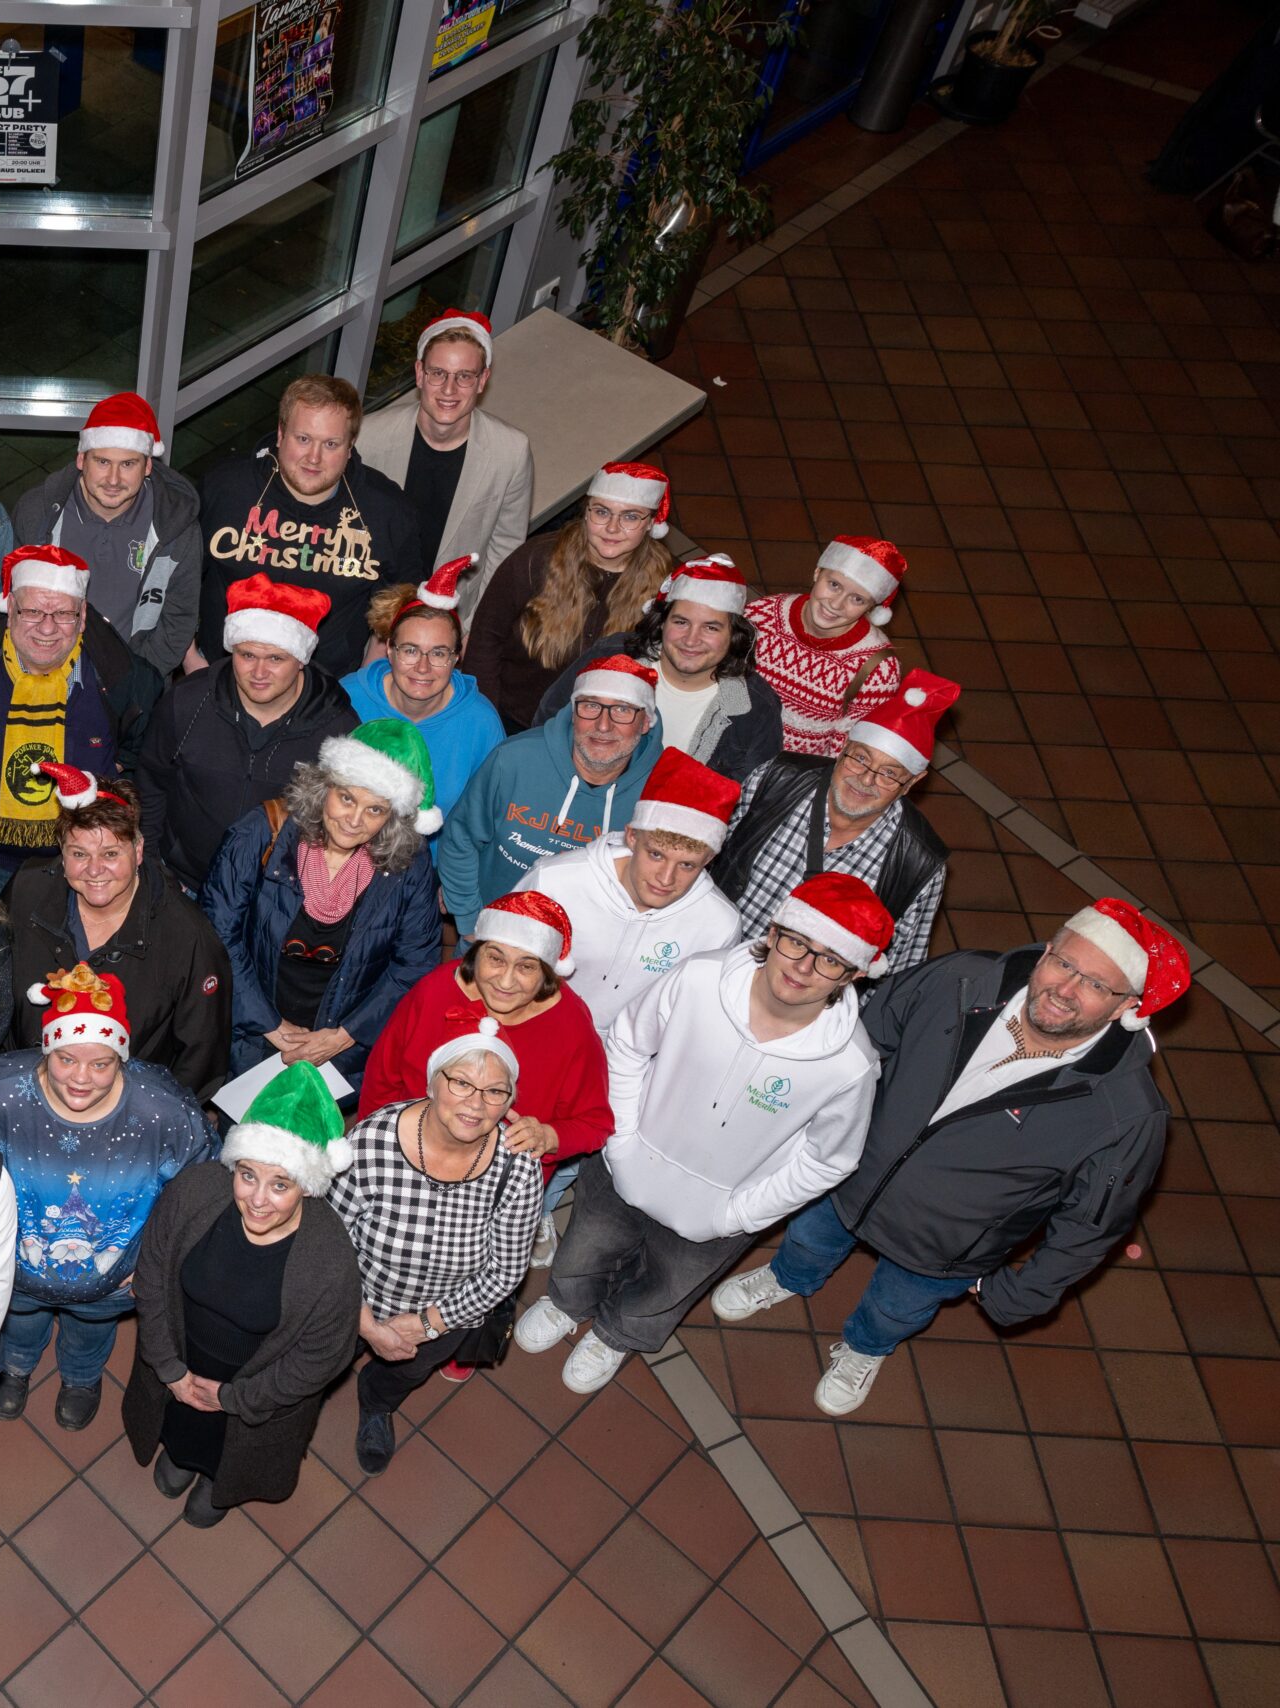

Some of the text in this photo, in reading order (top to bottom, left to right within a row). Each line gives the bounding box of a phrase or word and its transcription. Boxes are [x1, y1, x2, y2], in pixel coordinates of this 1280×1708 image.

[12, 124, 47, 132] PARTY
[245, 506, 343, 556] Merry
[210, 527, 380, 581] Christmas
[508, 831, 556, 857] Premium
